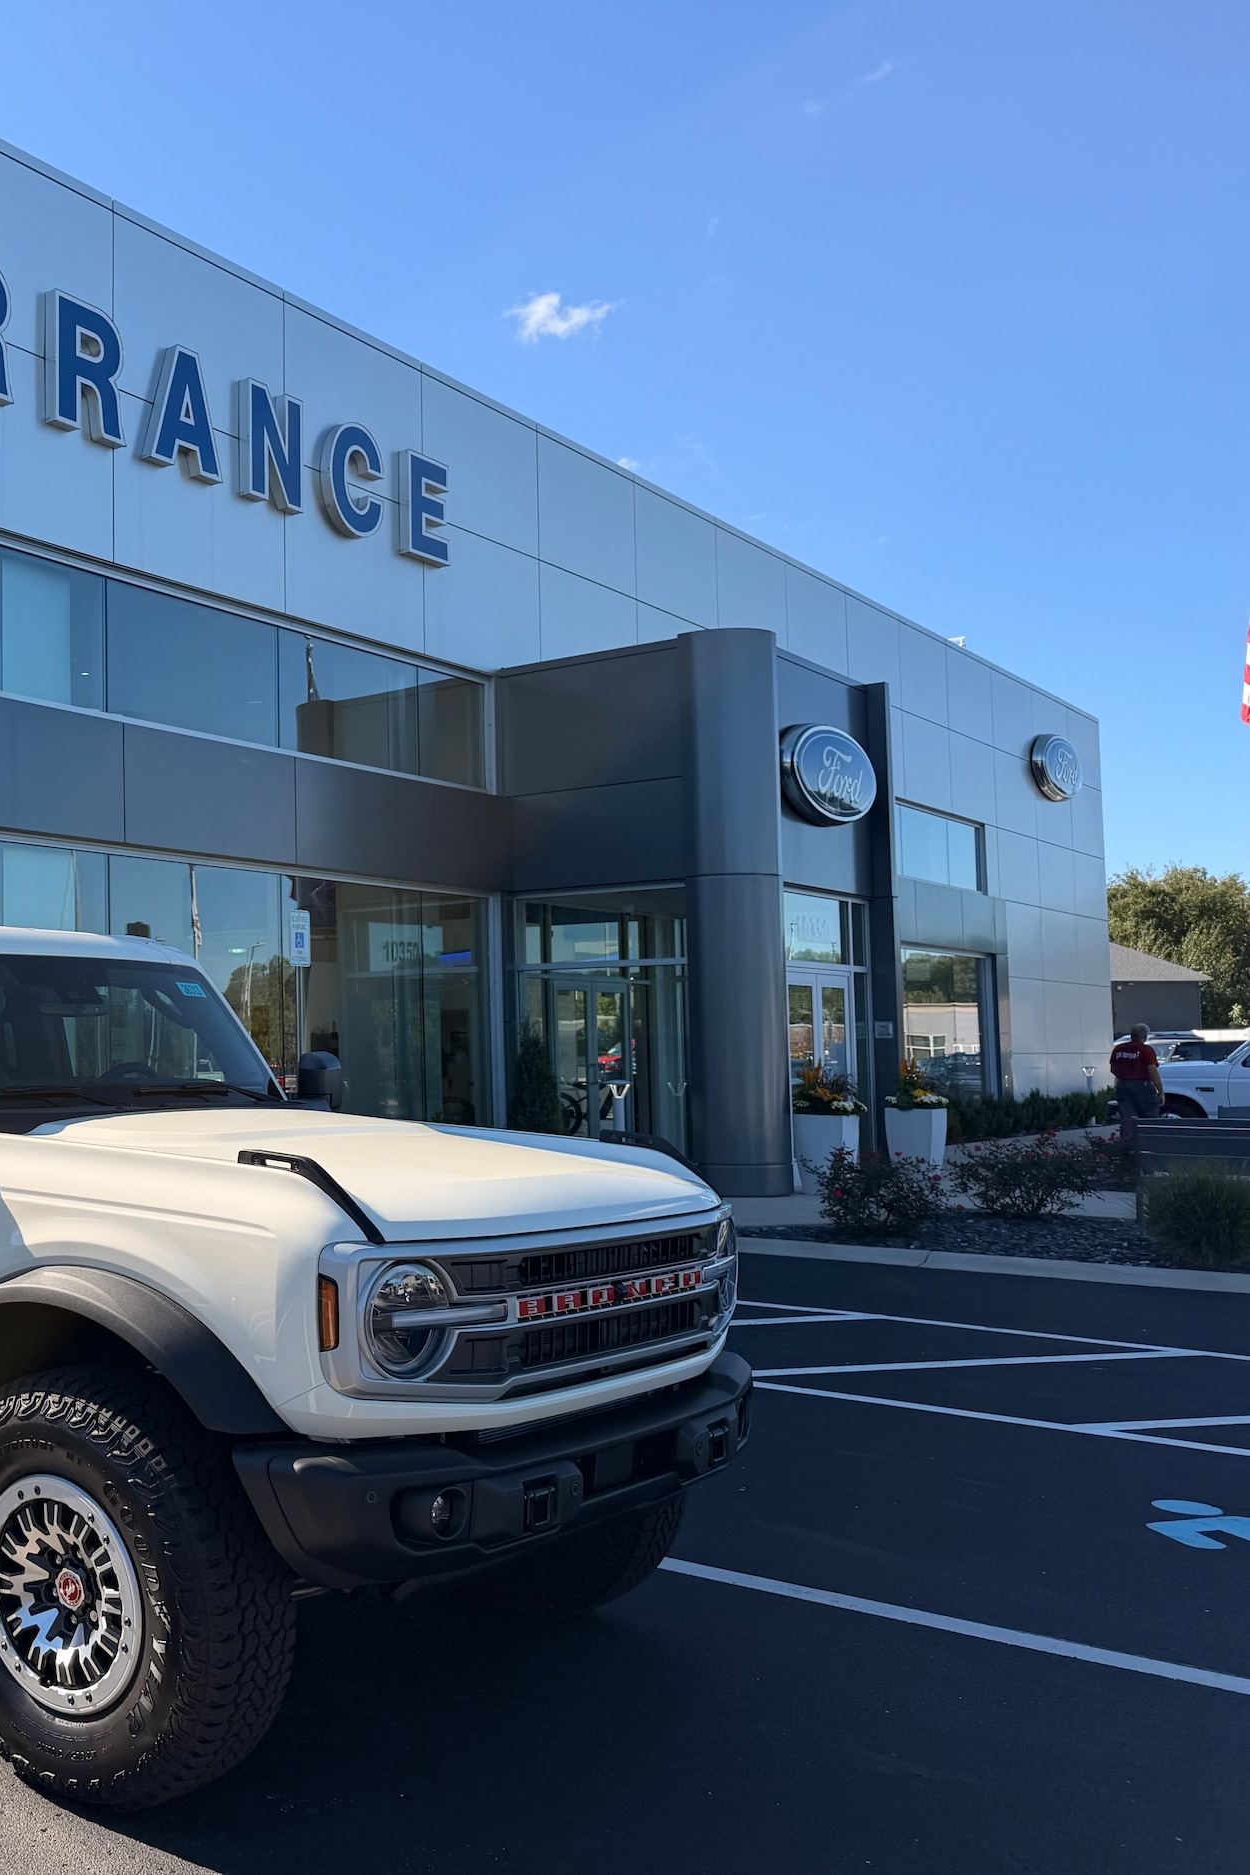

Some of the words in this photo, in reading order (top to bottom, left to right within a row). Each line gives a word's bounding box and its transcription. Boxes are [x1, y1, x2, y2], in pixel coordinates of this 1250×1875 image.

[818, 746, 863, 804] Ford
[1055, 748, 1079, 785] Ford
[517, 1270, 701, 1319] BRONCO
